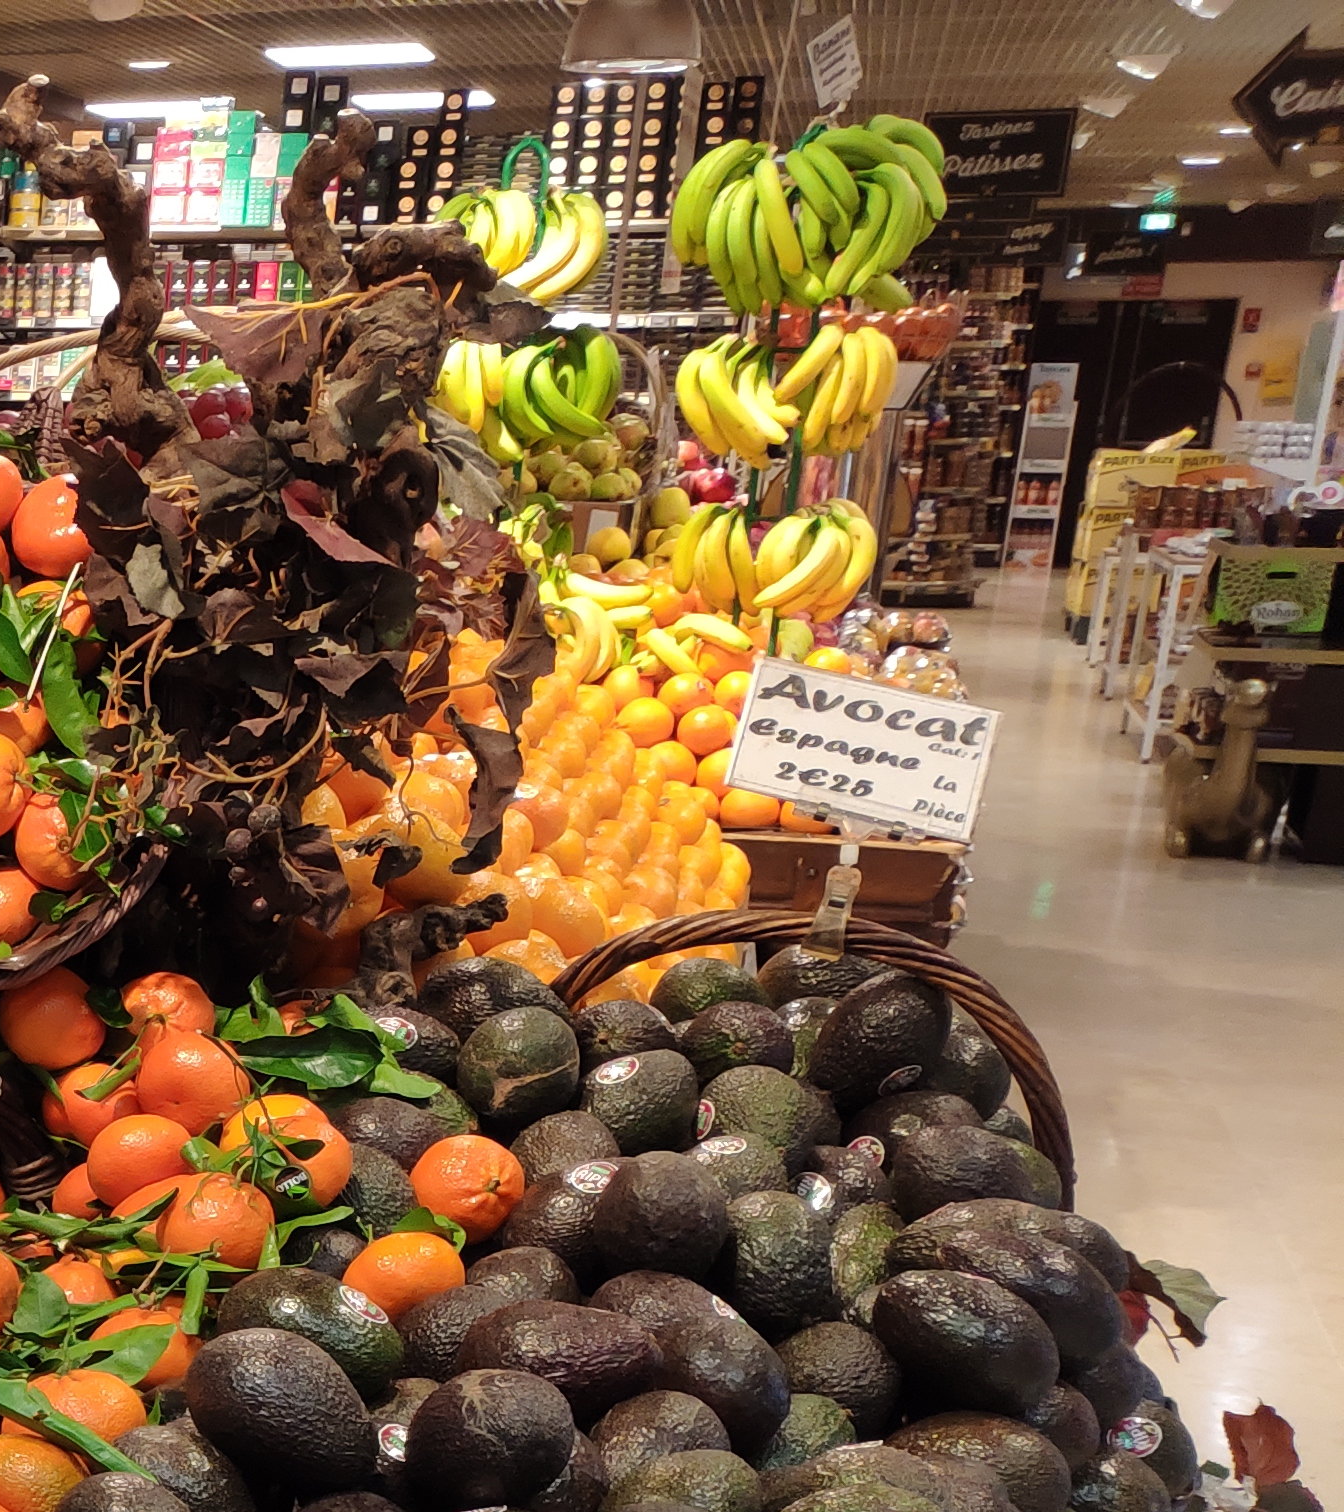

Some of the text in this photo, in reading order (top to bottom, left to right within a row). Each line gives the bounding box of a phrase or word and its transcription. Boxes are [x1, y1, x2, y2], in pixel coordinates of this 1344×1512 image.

[757, 674, 987, 746] Avocat
[774, 761, 957, 797] 2€25 La
[912, 799, 966, 823] Pièce
[578, 1169, 610, 1189] RIPE
